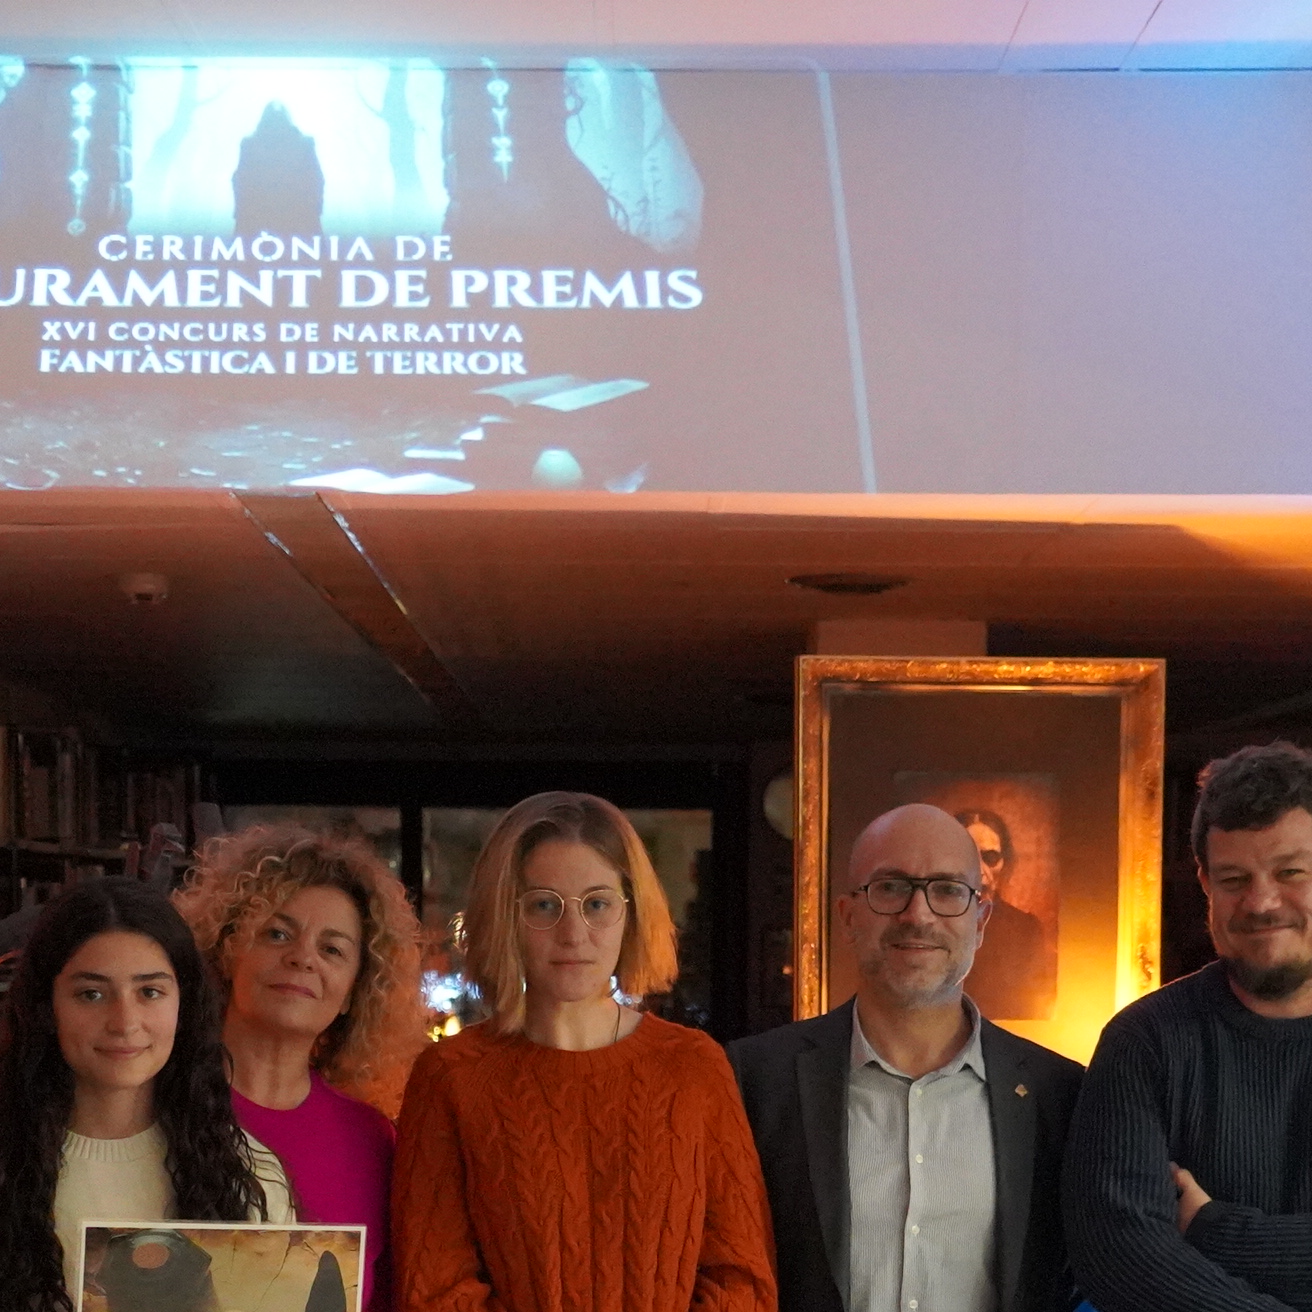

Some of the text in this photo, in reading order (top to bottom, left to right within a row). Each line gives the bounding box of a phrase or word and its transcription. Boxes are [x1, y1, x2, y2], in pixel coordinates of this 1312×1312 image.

[98, 231, 453, 262] CERIMÒNIA DE
[338, 268, 431, 308] DE
[450, 267, 704, 309] PREMIS
[42, 320, 524, 345] XVI CONCURS DE NARRATIVA
[39, 345, 526, 376] FANTÀSTICA I DE TERROR
